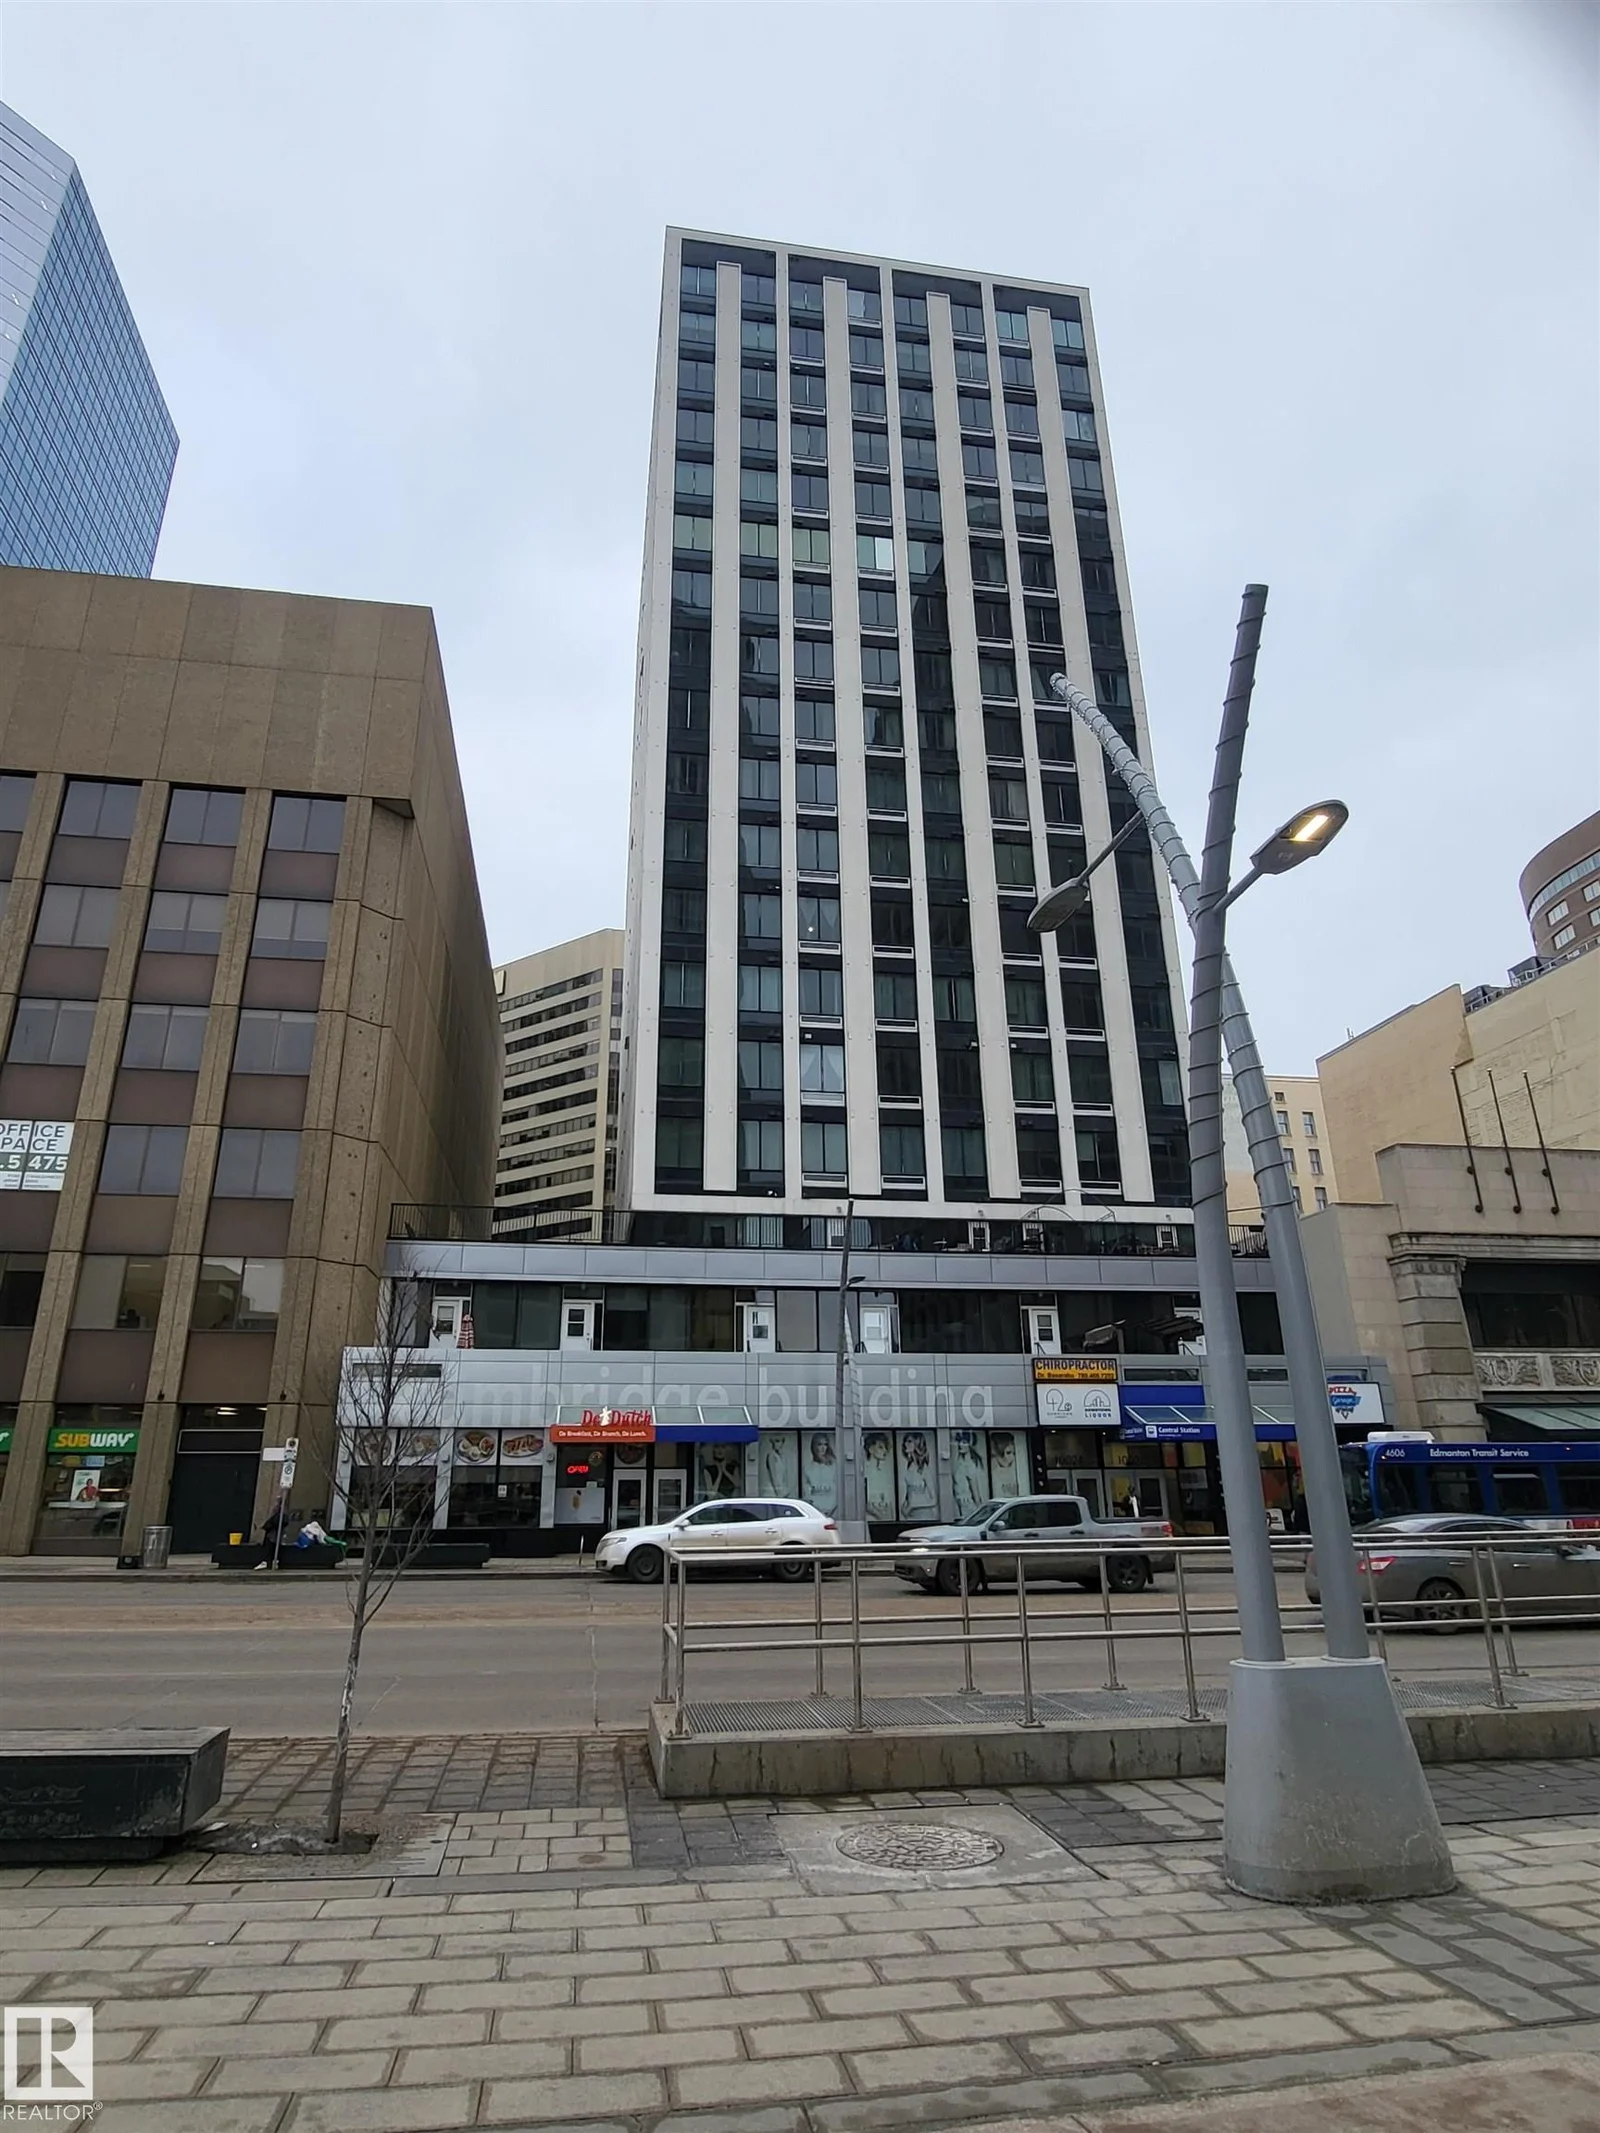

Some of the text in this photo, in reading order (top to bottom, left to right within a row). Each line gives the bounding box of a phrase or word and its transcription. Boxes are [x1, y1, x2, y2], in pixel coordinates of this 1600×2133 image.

[1035, 1360, 1115, 1371] CHIROPRACTOR
[759, 1366, 994, 1427] bulding
[581, 1408, 652, 1426] De Dutch
[1158, 1426, 1201, 1434] Central Station
[54, 1432, 135, 1448] SUBWAY
[1385, 1448, 1530, 1458] 4606 Edmonton Transit Service
